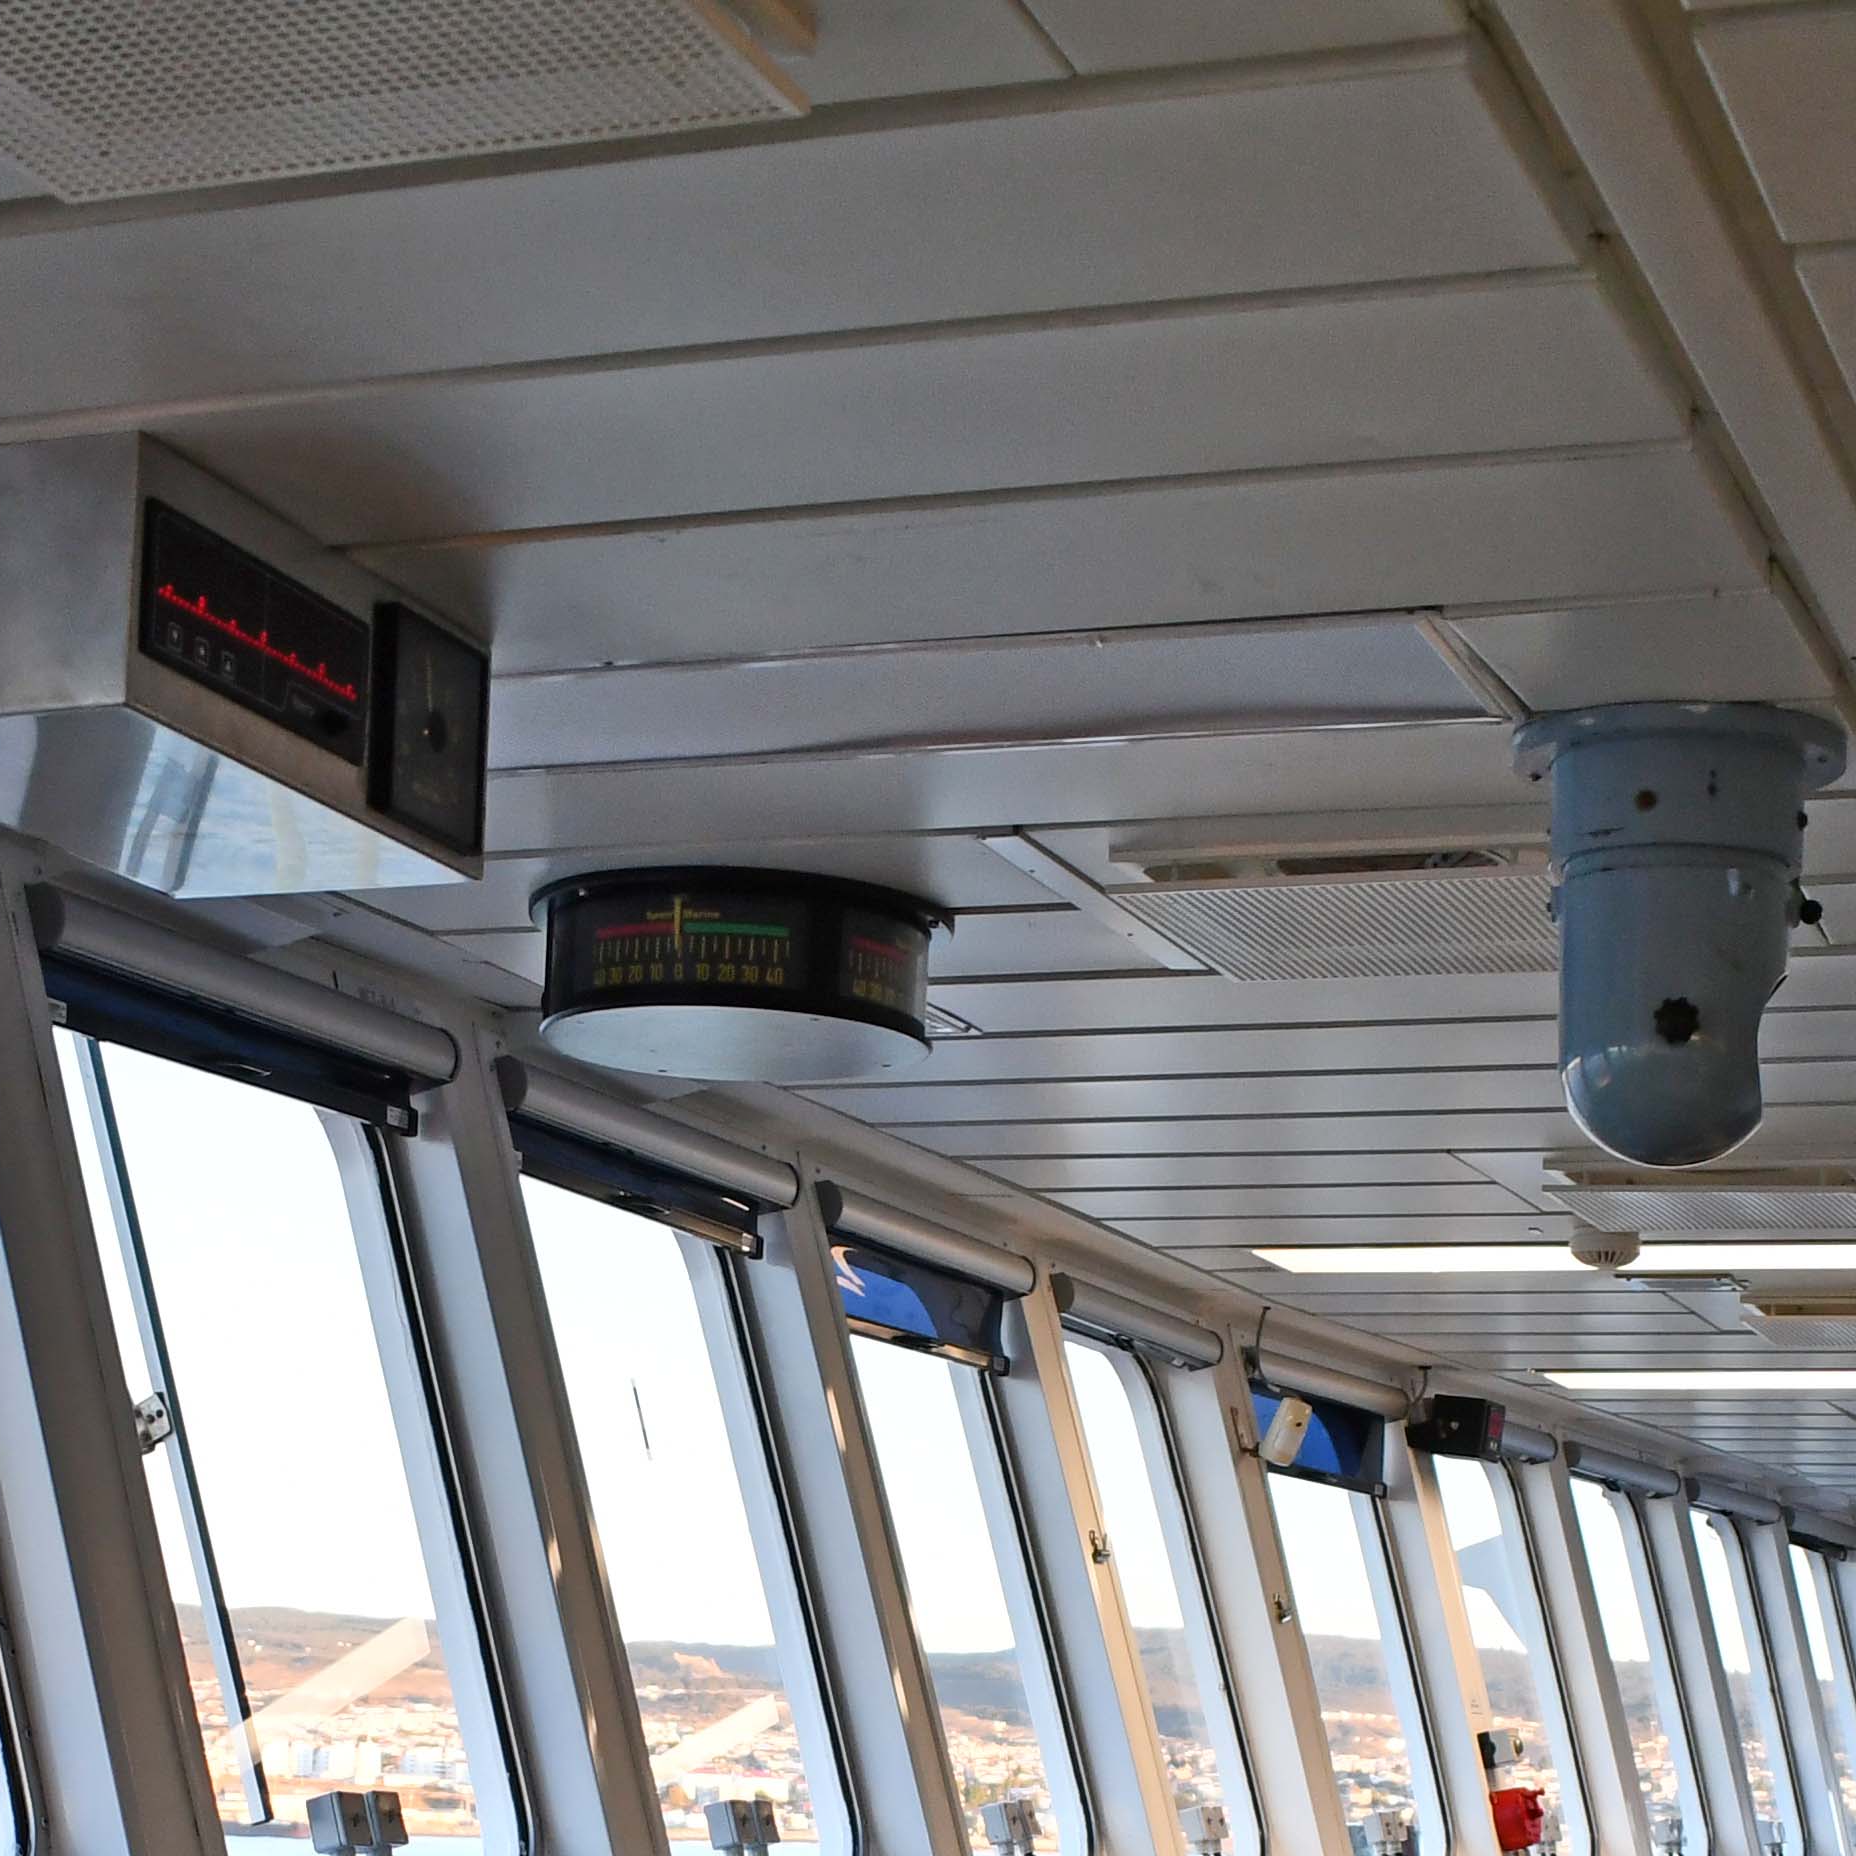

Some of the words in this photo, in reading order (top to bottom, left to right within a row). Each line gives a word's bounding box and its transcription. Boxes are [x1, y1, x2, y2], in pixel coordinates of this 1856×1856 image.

[629, 963, 643, 984] 20
[650, 963, 664, 982] 10
[697, 962, 710, 981] 10
[718, 963, 736, 982] 20
[743, 964, 760, 984] 30
[765, 966, 784, 986] 40
